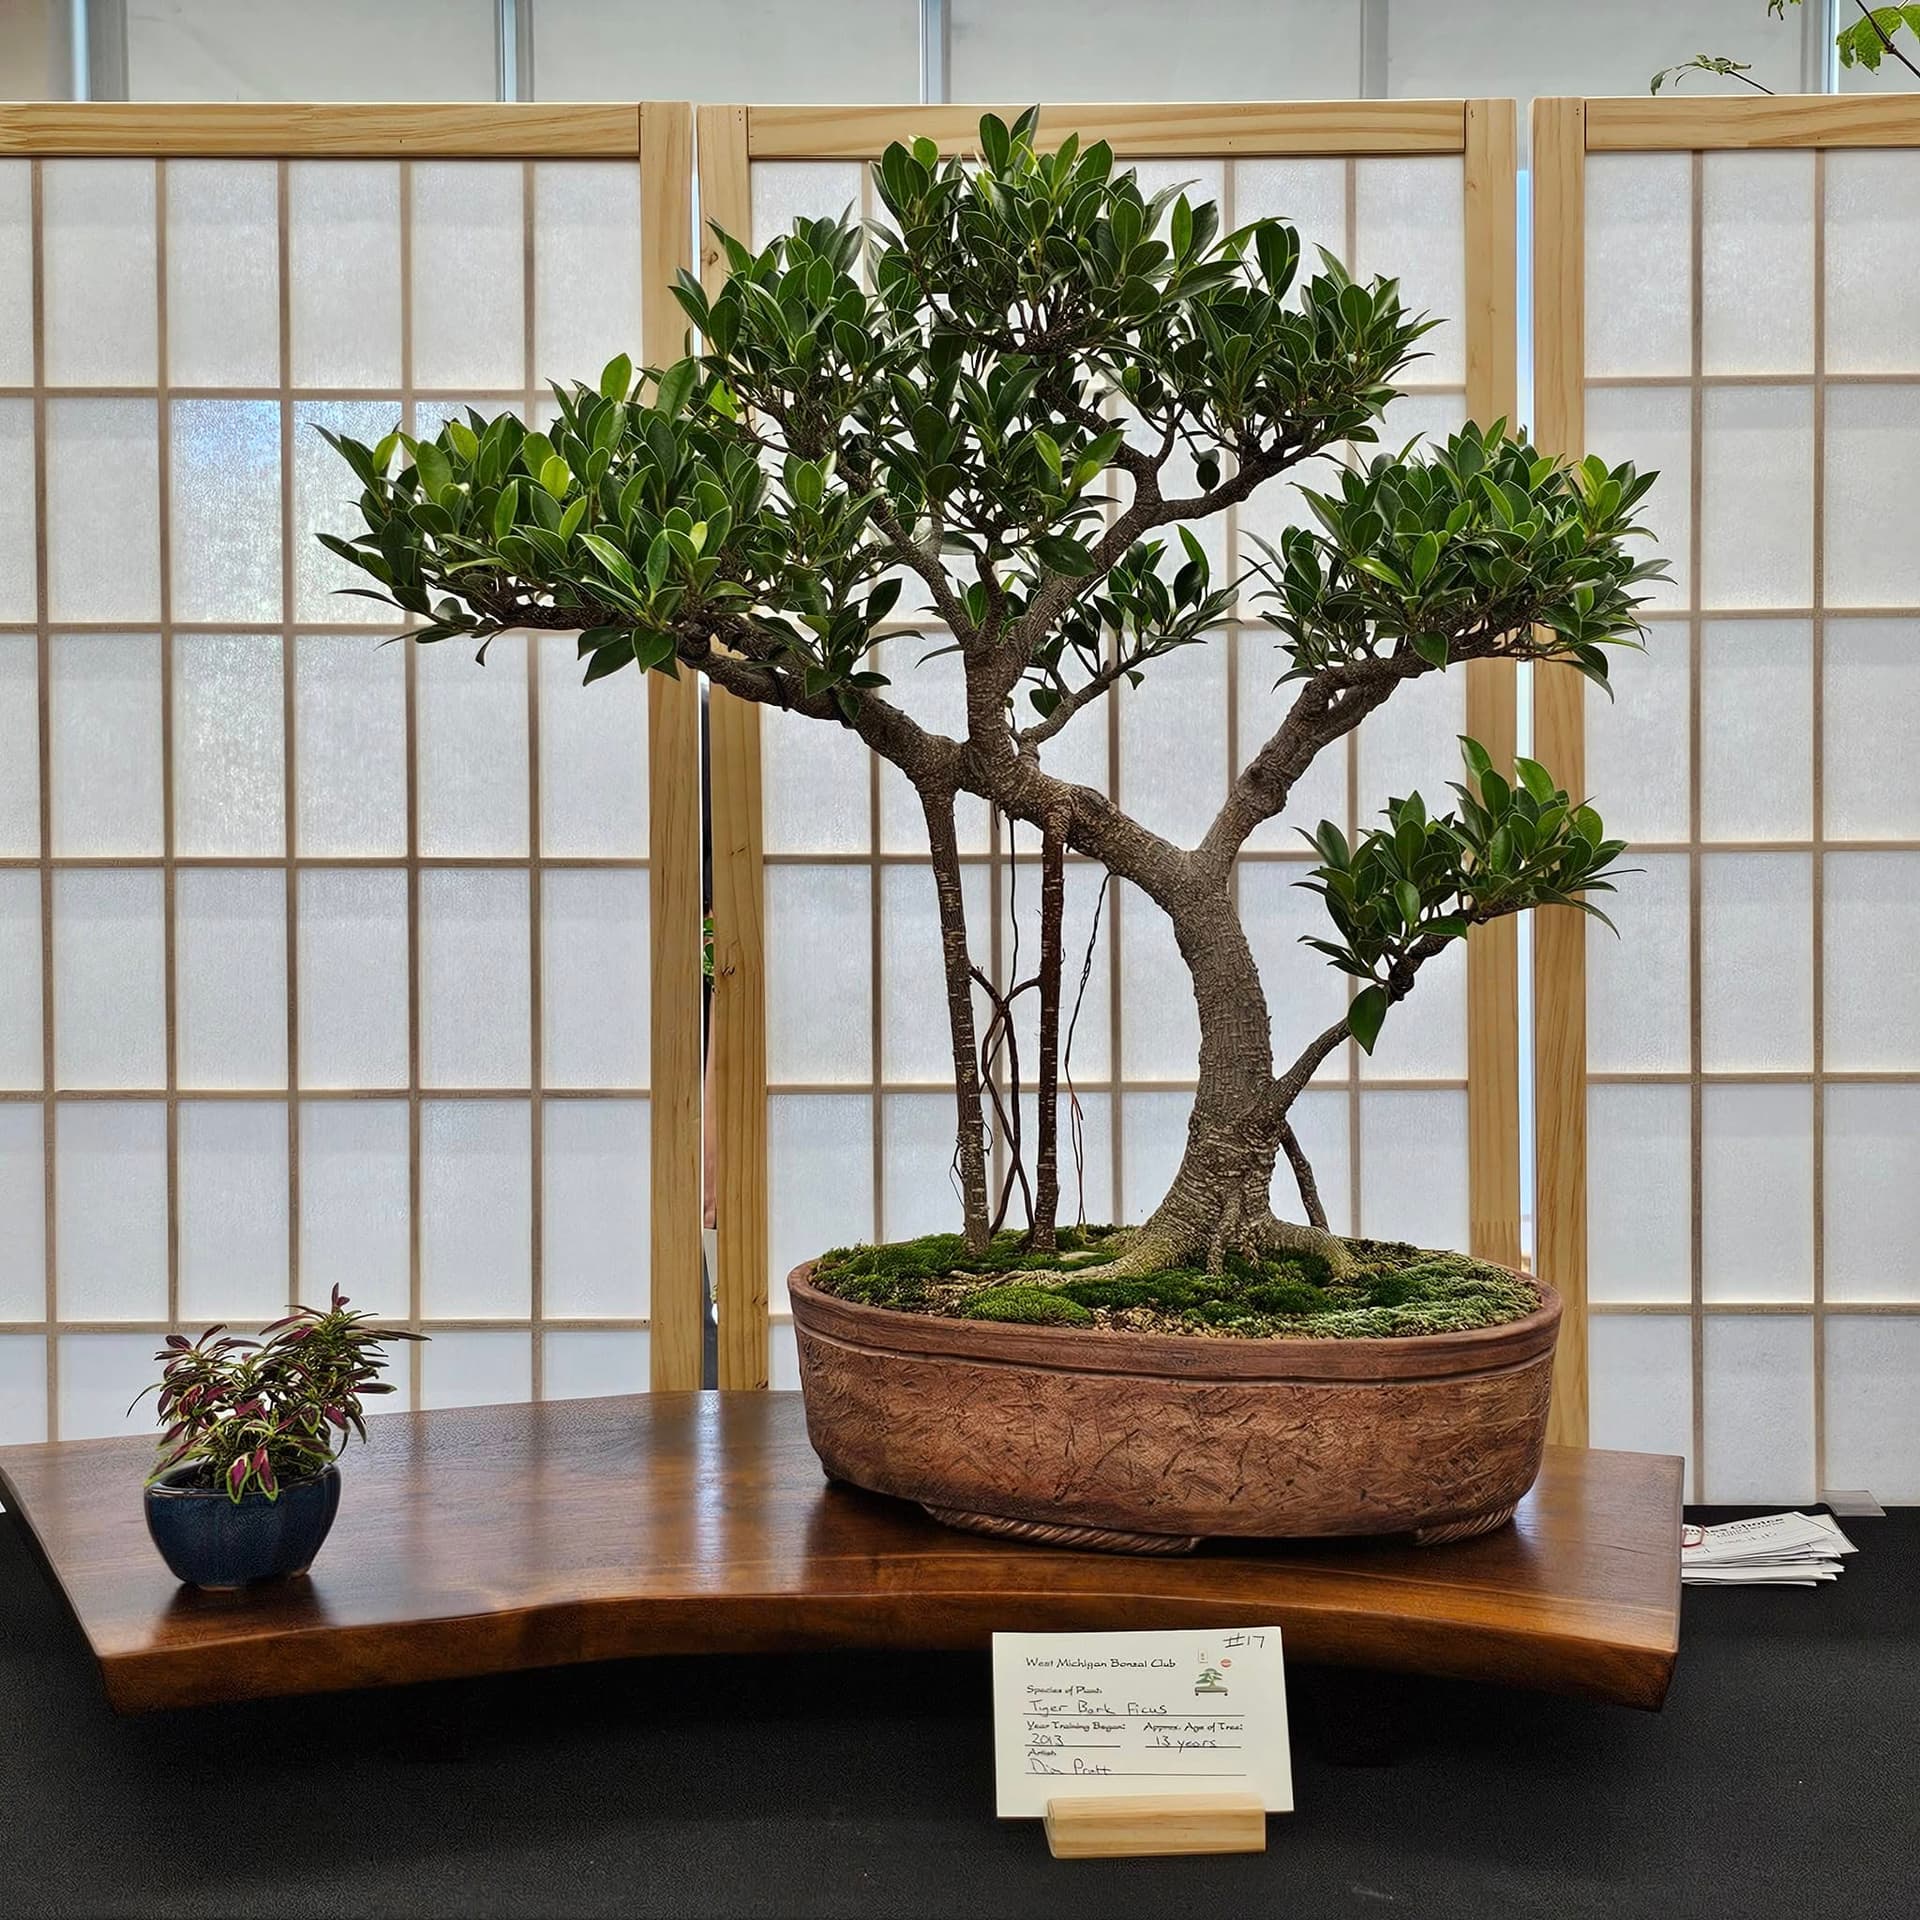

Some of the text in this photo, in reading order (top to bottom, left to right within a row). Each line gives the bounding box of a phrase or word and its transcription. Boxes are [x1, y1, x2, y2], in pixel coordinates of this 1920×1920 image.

[1222, 1632, 1265, 1648] #17
[1026, 1657, 1176, 1670] West Michigan Bonsai Club
[1026, 1685, 1062, 1695] Species
[1065, 1685, 1074, 1696] of
[1029, 1699, 1068, 1717] Tiger
[1128, 1702, 1168, 1715] Ficus
[1027, 1721, 1050, 1731] Year
[1051, 1721, 1090, 1732] Training
[1184, 1722, 1204, 1732] Age
[1207, 1722, 1216, 1732] of
[1219, 1722, 1243, 1731] Tree:
[1032, 1732, 1065, 1746] 2013
[1155, 1734, 1217, 1753] 13 years
